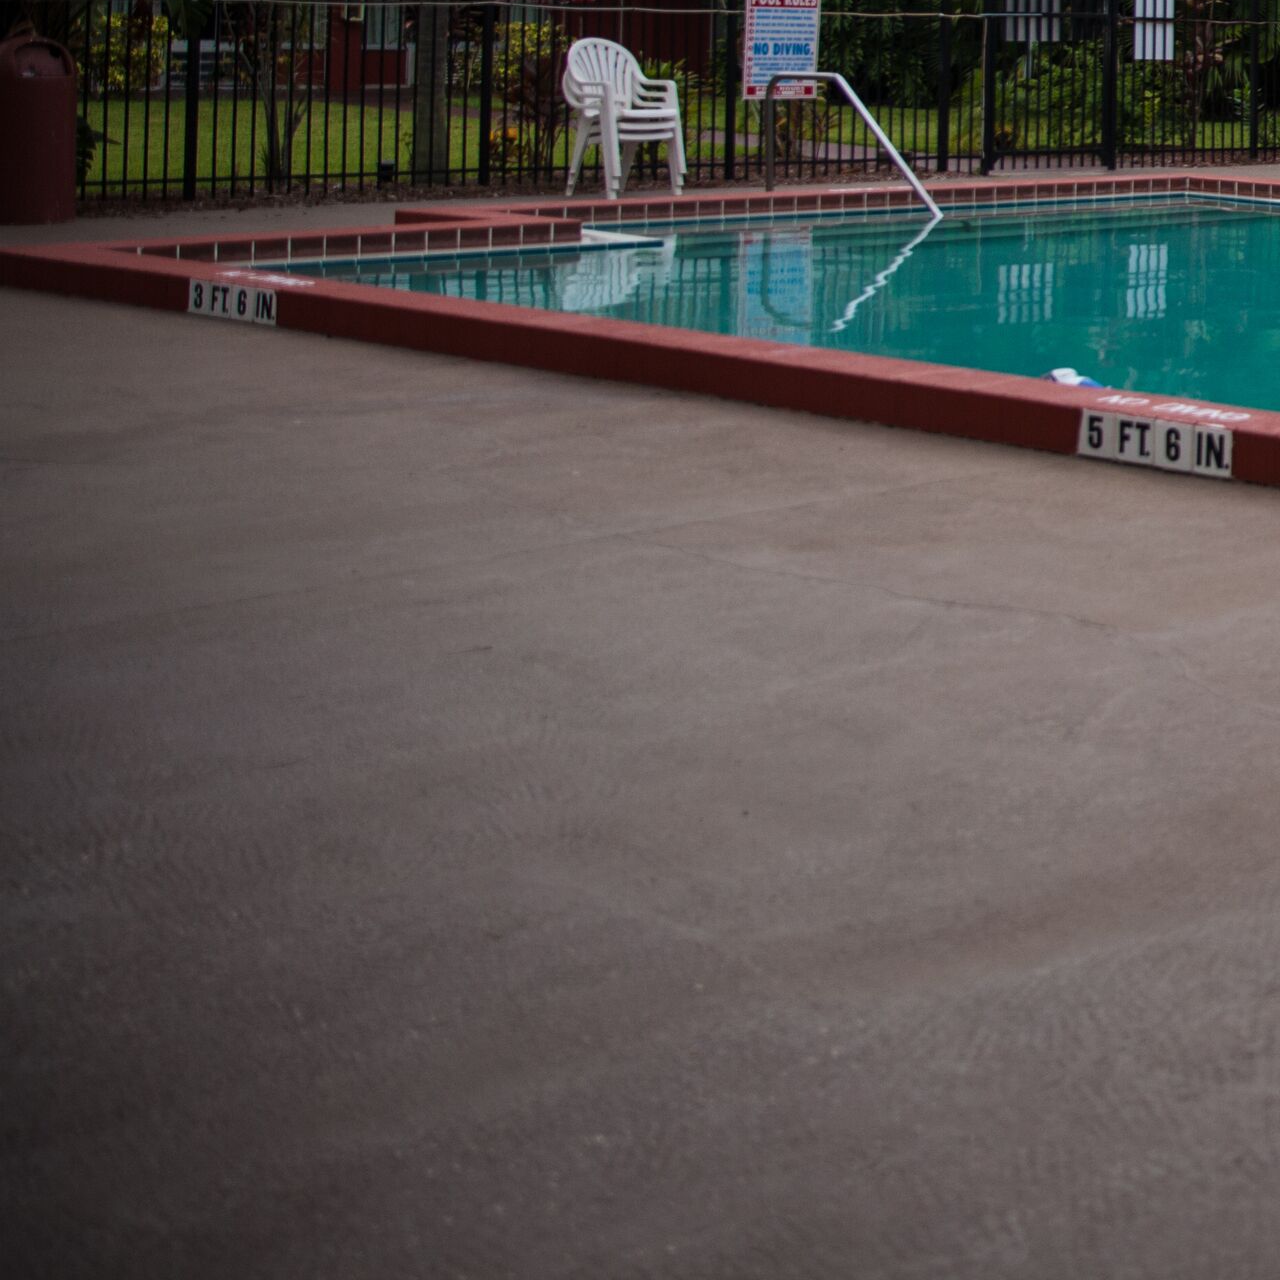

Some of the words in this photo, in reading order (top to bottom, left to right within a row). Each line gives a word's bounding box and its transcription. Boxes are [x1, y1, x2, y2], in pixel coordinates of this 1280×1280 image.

[753, 42, 769, 55] NO
[773, 42, 814, 56] DIVING.
[194, 283, 204, 309] 3
[211, 286, 229, 314] FT.
[237, 289, 248, 315] 6
[1088, 416, 1103, 449] 5
[1119, 420, 1150, 456] FT.
[1166, 427, 1180, 461] 6
[1197, 431, 1229, 469] IN.
